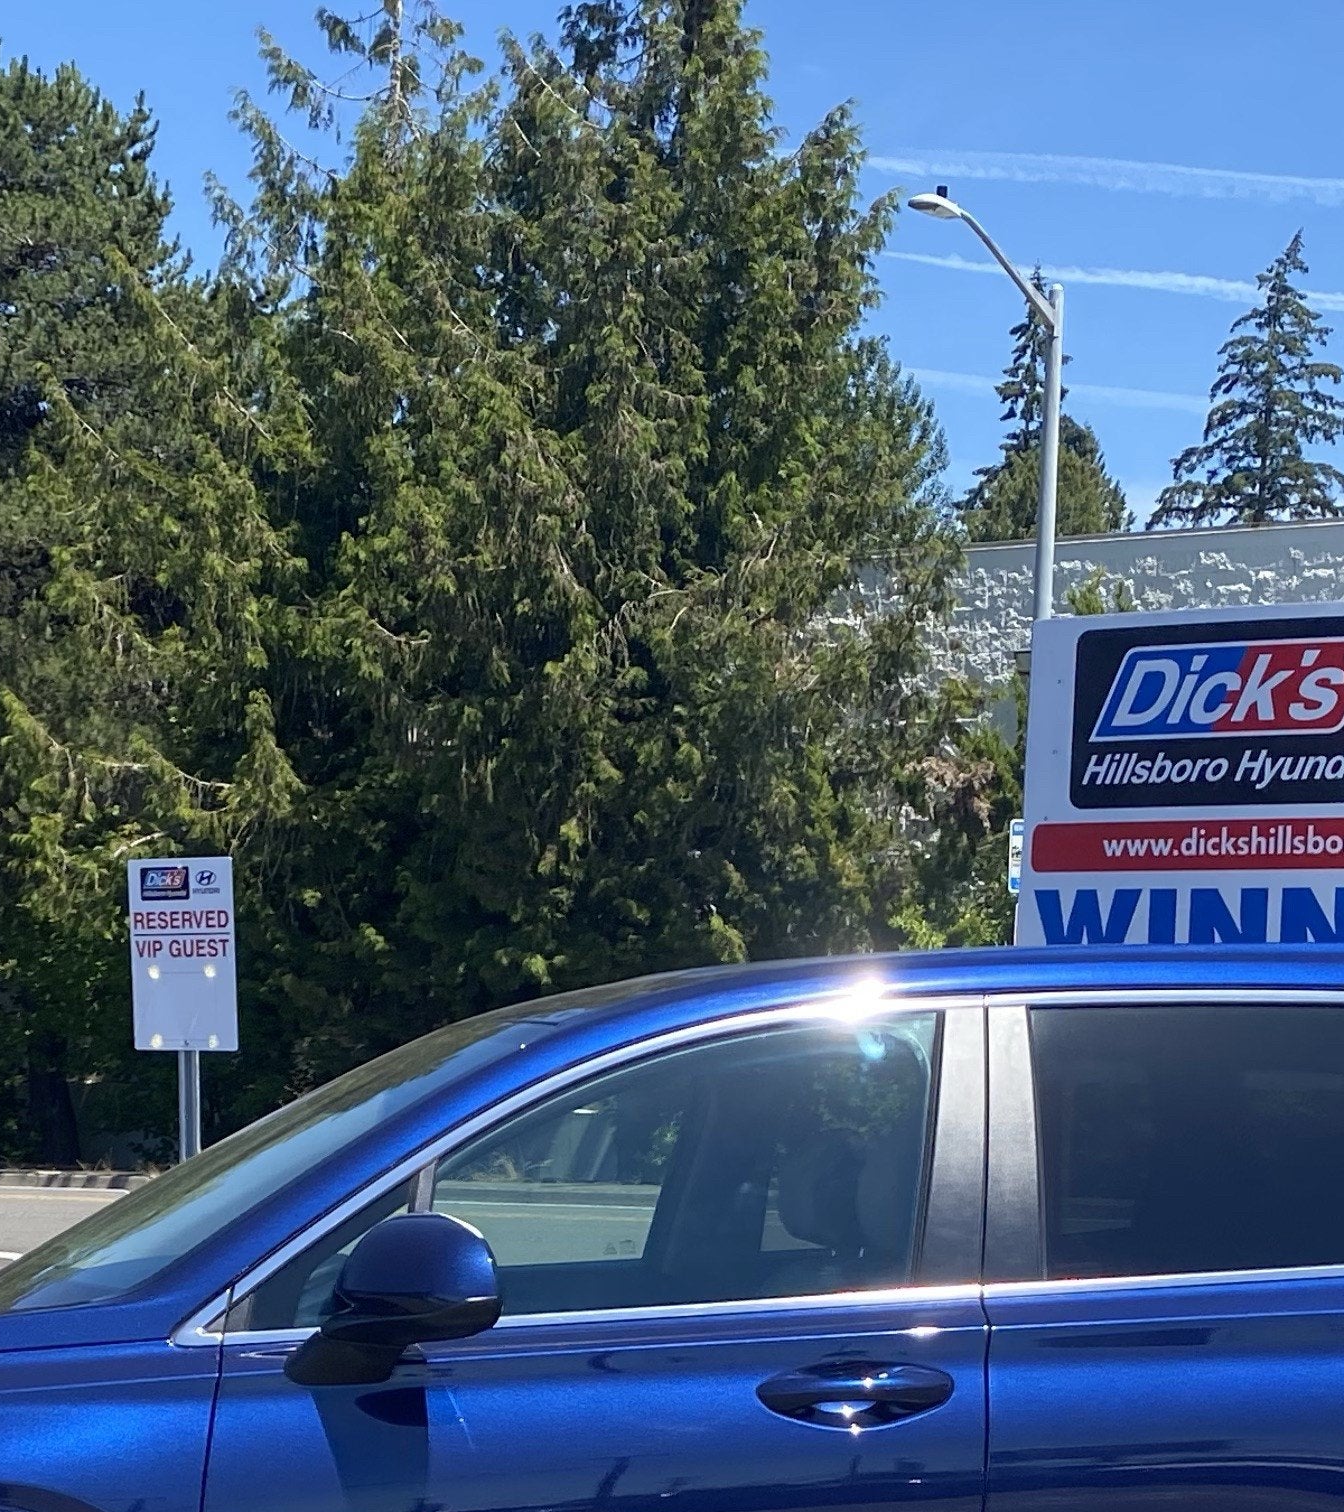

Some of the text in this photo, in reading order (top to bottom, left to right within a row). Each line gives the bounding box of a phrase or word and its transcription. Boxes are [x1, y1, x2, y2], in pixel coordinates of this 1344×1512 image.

[1081, 752, 1229, 786] Hillsboro
[133, 910, 229, 930] RESERVED
[134, 939, 229, 958] VIP GUEST
